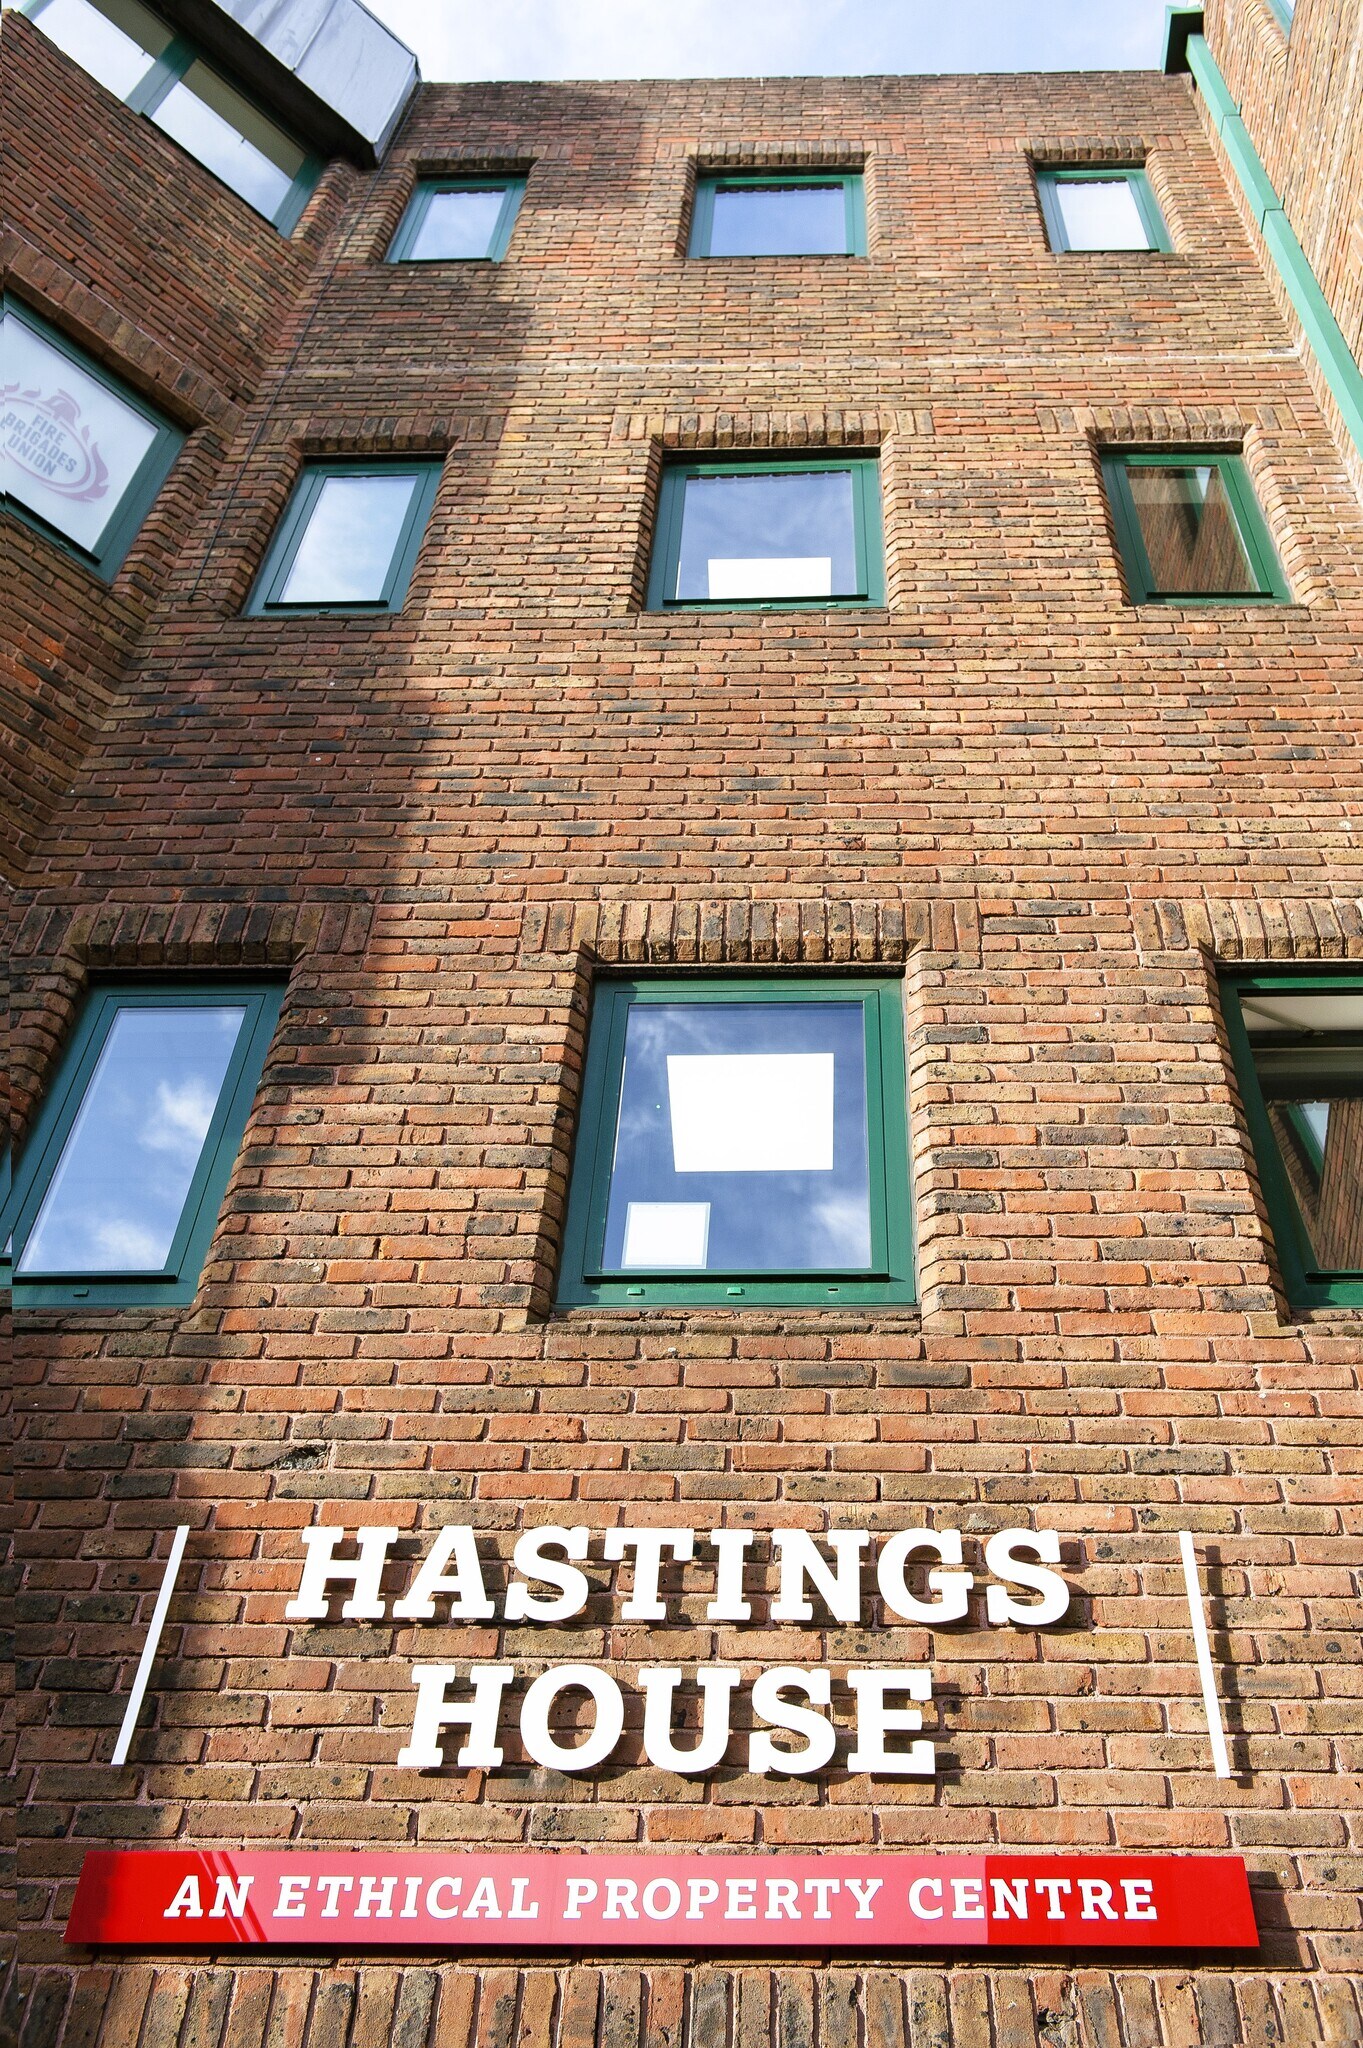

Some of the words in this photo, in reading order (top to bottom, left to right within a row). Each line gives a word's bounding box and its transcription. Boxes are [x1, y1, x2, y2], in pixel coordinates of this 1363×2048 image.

[3, 411, 78, 473] BRIGADES
[7, 435, 58, 477] UNION
[32, 413, 67, 446] FIRE
[285, 1525, 1070, 1626] HASTINGS
[397, 1664, 936, 1775] HOUSE
[164, 1876, 253, 1919] AN
[272, 1876, 540, 1919] ETHICAL
[563, 1877, 884, 1920] PROPERTY
[908, 1877, 1158, 1920] CENTRE
